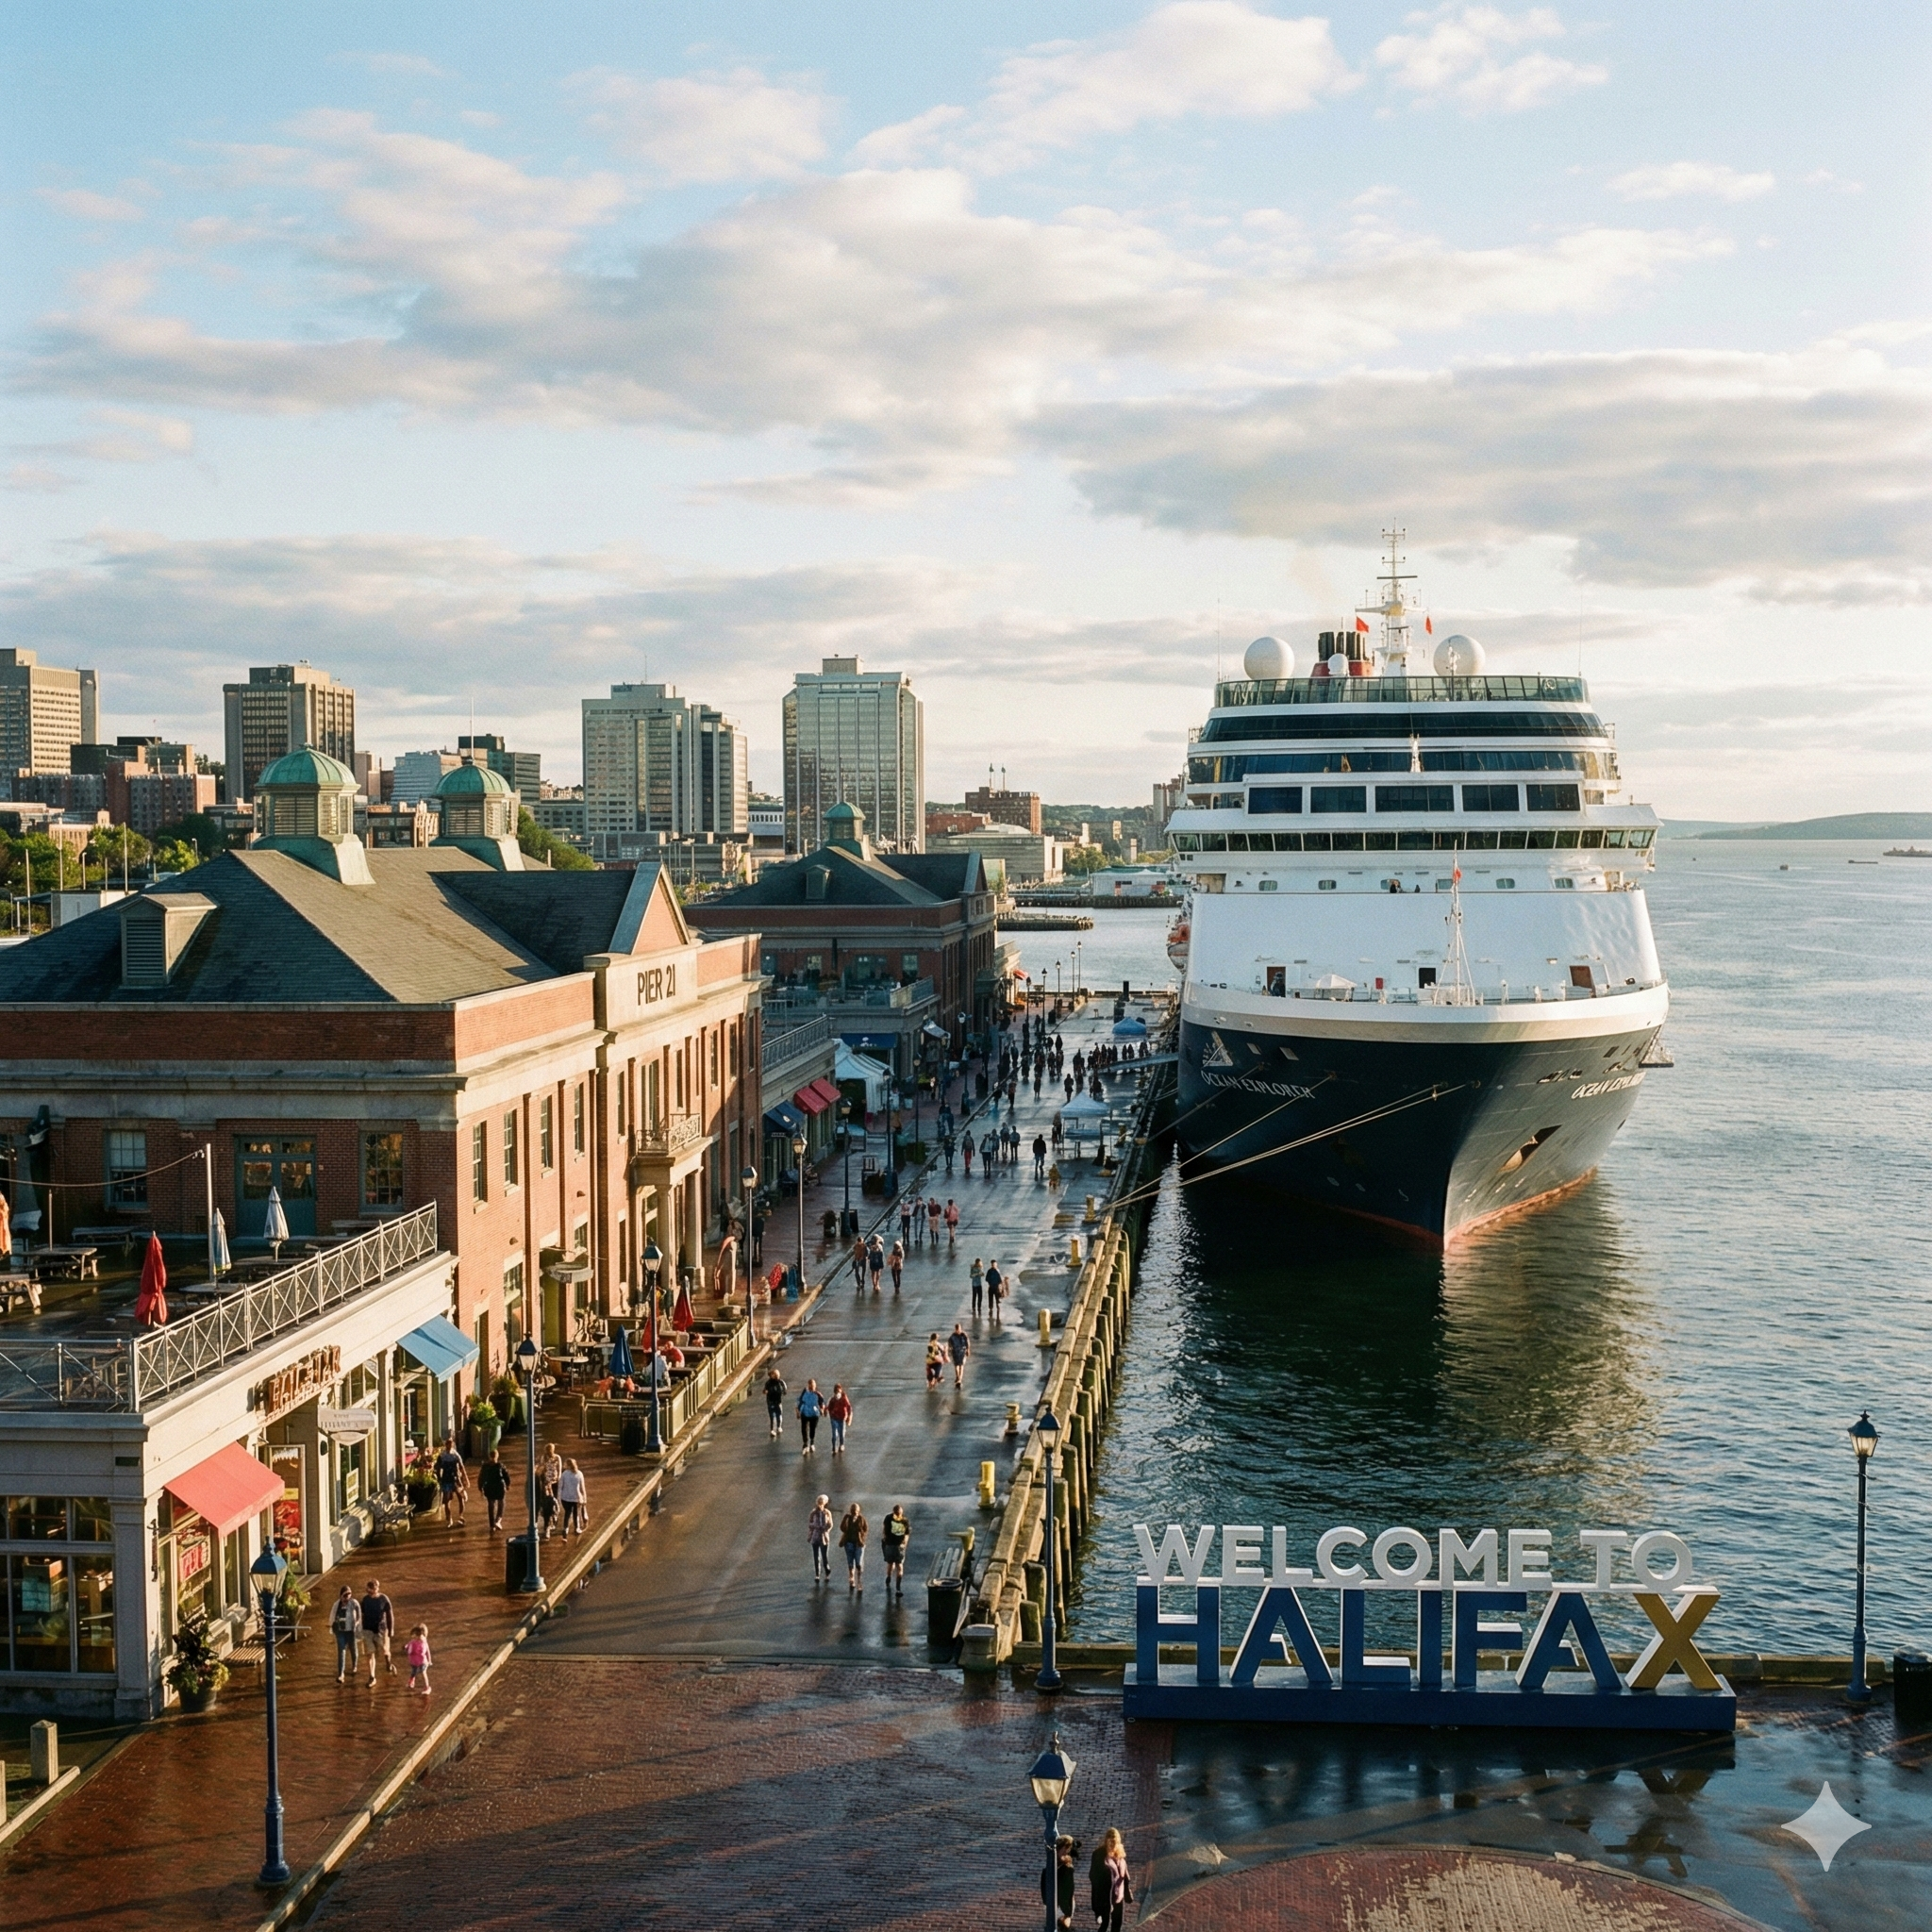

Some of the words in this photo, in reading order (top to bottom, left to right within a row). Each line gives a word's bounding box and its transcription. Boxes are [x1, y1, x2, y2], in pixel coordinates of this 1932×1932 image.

[637, 968, 663, 1006] PIER
[666, 963, 676, 998] 21
[1133, 1523, 1552, 1591] WELCOME
[1580, 1529, 1692, 1592] TO
[1136, 1585, 1724, 1690] HALIFAX
